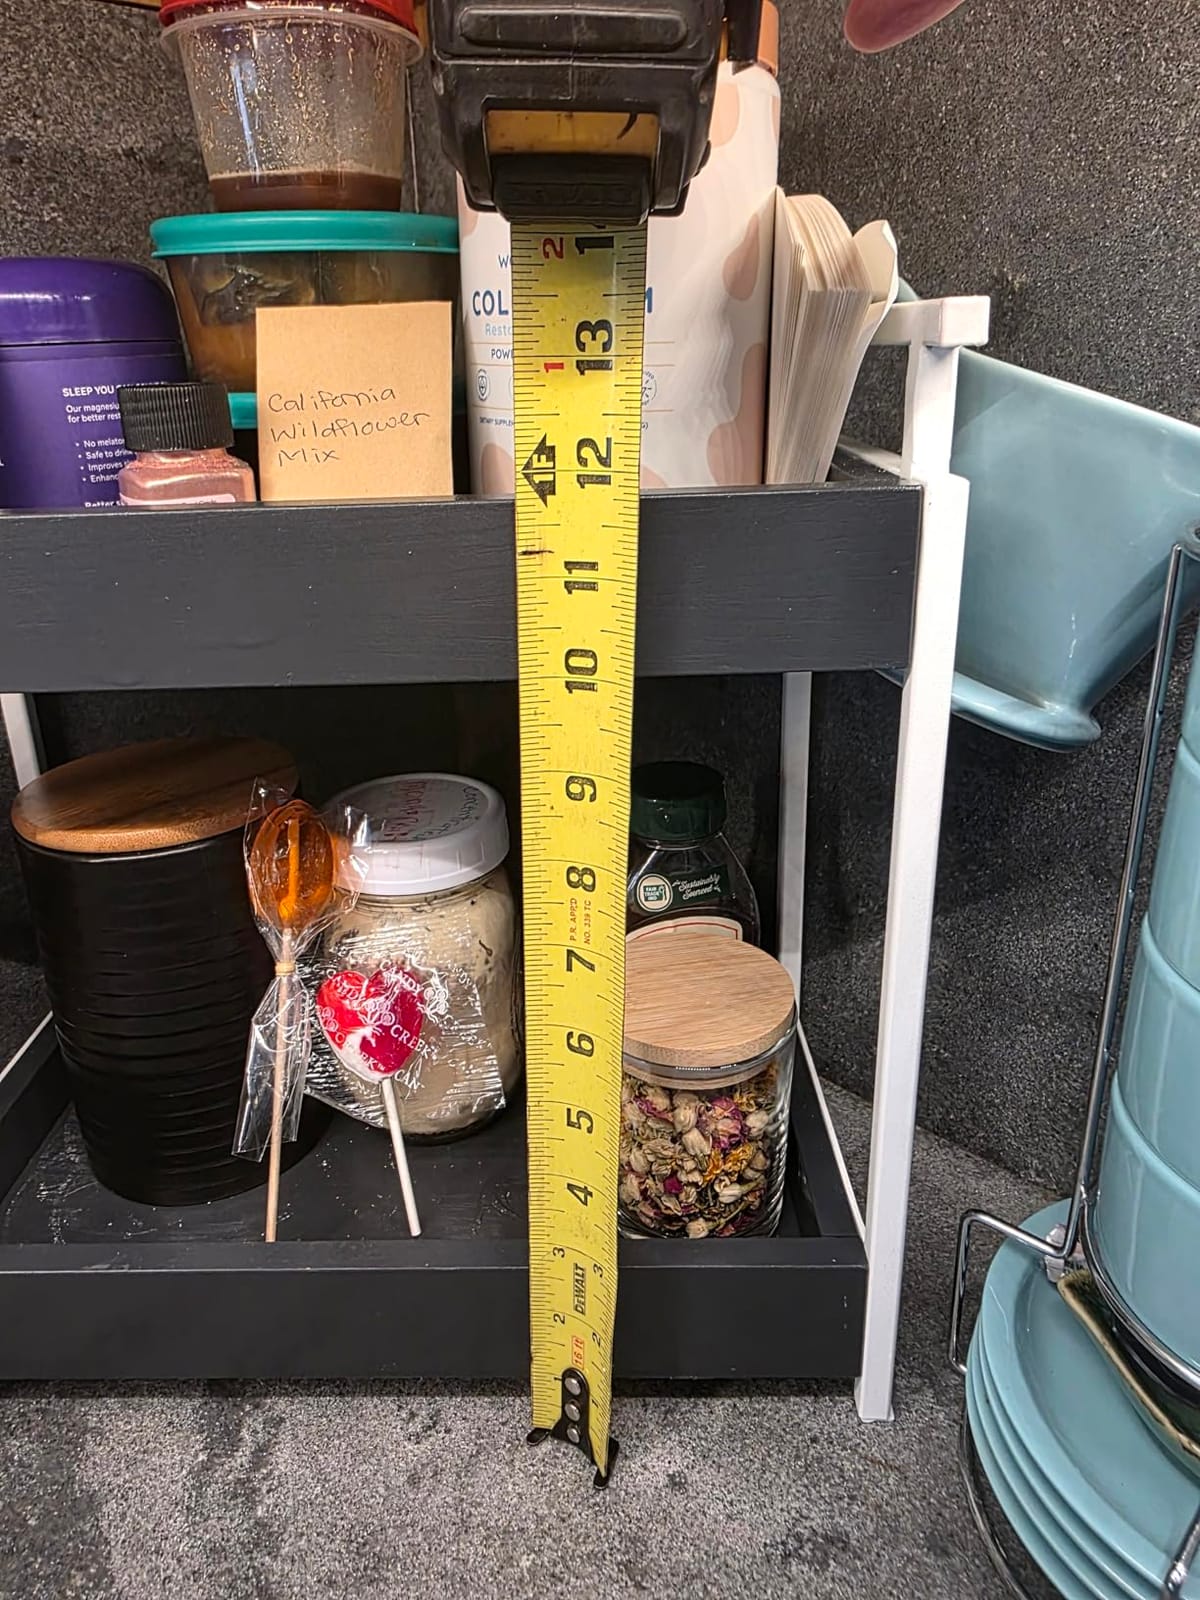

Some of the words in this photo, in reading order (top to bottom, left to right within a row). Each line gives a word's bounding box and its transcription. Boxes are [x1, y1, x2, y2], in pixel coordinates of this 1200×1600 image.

[542, 237, 565, 259] 2
[575, 223, 615, 255] 1
[472, 290, 509, 317] COL
[575, 319, 613, 376] 13
[544, 362, 565, 373] 1
[62, 386, 93, 397] SLEEP
[94, 385, 115, 395] YOU
[268, 388, 396, 413] California
[65, 403, 82, 413] Our
[67, 414, 81, 423] for
[81, 412, 106, 422] better
[270, 413, 431, 443] Wildflower
[83, 440, 96, 448] No
[85, 451, 104, 460] Safe
[104, 450, 114, 458] to
[87, 461, 124, 472] Improves
[278, 448, 339, 467] Mix
[576, 437, 613, 489] 12
[563, 561, 599, 595] 11
[564, 648, 598, 694] 10
[565, 775, 597, 803] 9
[565, 865, 596, 893] 8
[565, 948, 596, 973] 7
[566, 1031, 595, 1058] 6
[566, 1107, 594, 1134] 5
[566, 1182, 594, 1207] 4
[552, 1246, 565, 1259] 3
[592, 1263, 604, 1278] 3
[553, 1312, 566, 1325] 2
[591, 1332, 602, 1347] 2
[574, 1351, 583, 1366] 16
[591, 1398, 599, 1409] 1
